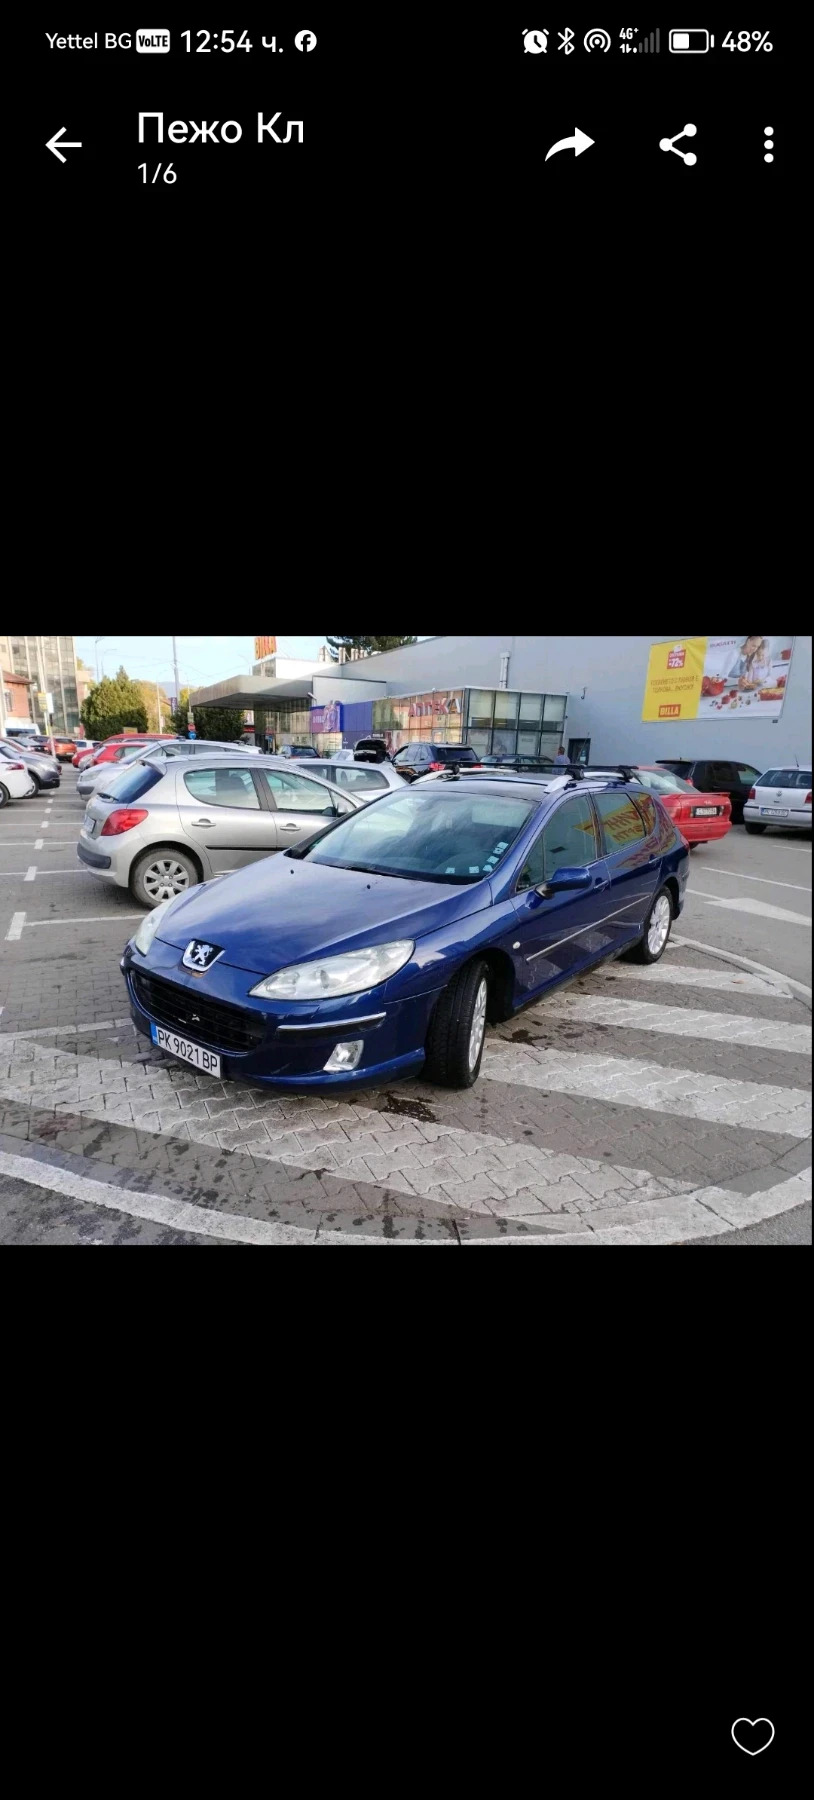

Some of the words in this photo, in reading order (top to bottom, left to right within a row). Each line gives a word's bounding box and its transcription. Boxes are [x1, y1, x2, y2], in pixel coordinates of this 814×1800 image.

[408, 697, 461, 718] АПТЕКА
[660, 706, 680, 716] BILLA
[173, 1038, 199, 1064] 9021
